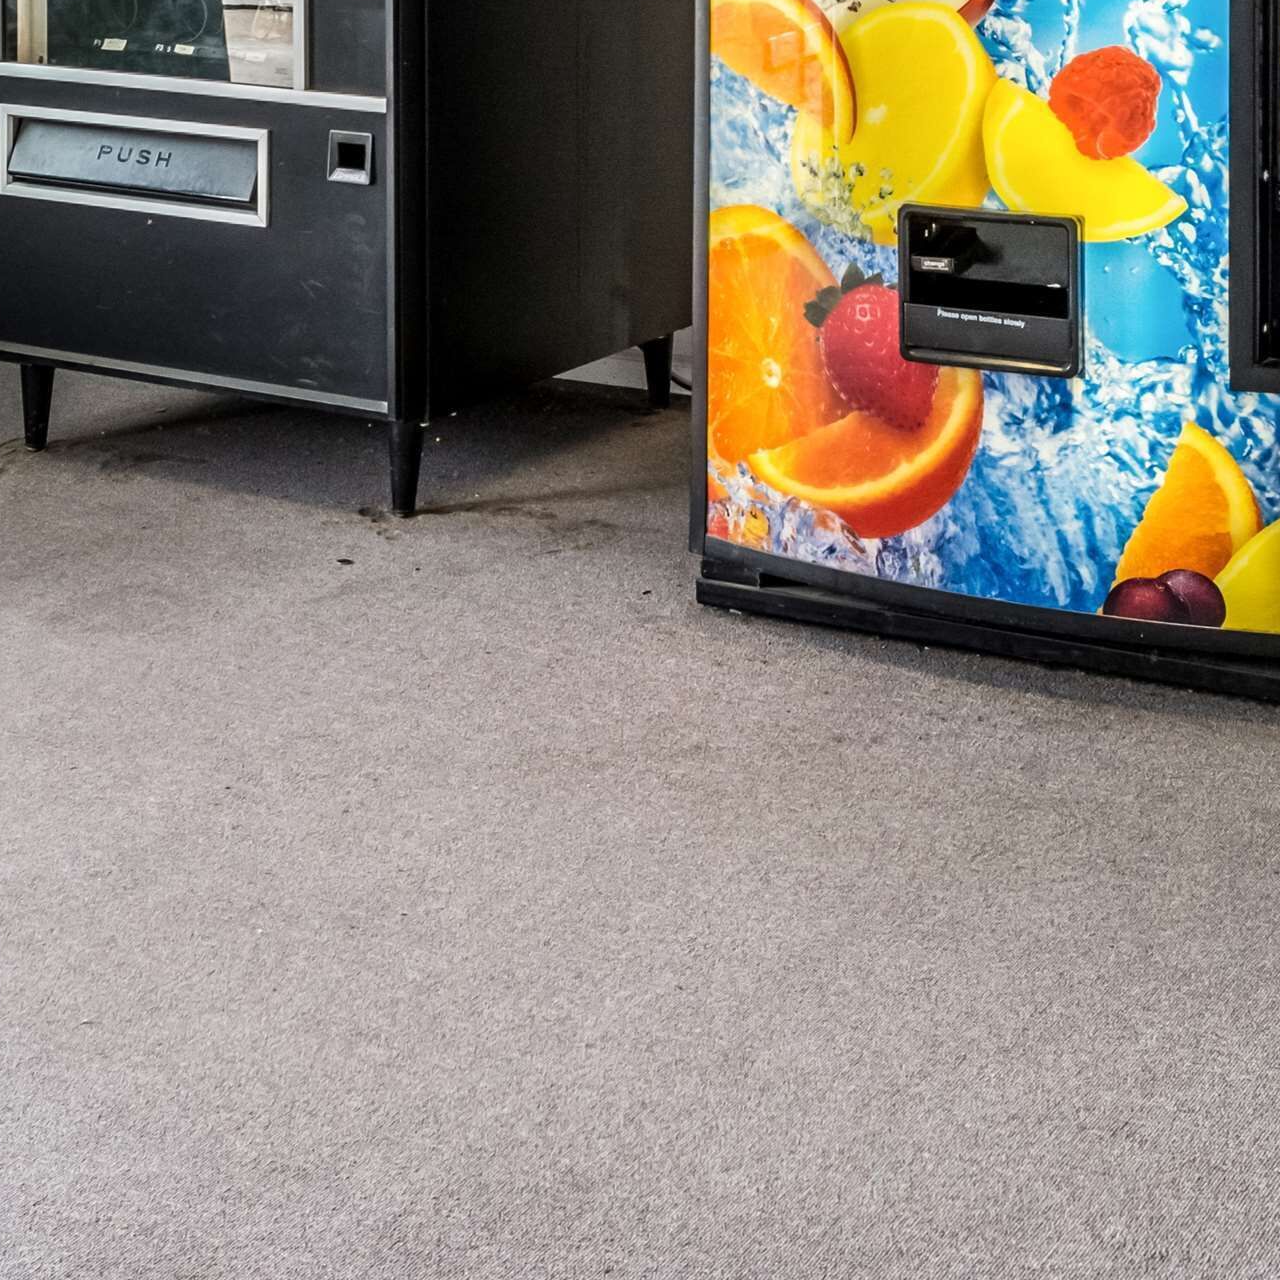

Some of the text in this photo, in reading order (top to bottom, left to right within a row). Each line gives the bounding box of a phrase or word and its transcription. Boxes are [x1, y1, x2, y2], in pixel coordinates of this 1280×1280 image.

[96, 144, 173, 168] PUSH
[936, 307, 1026, 329] Please open bottles slowly
